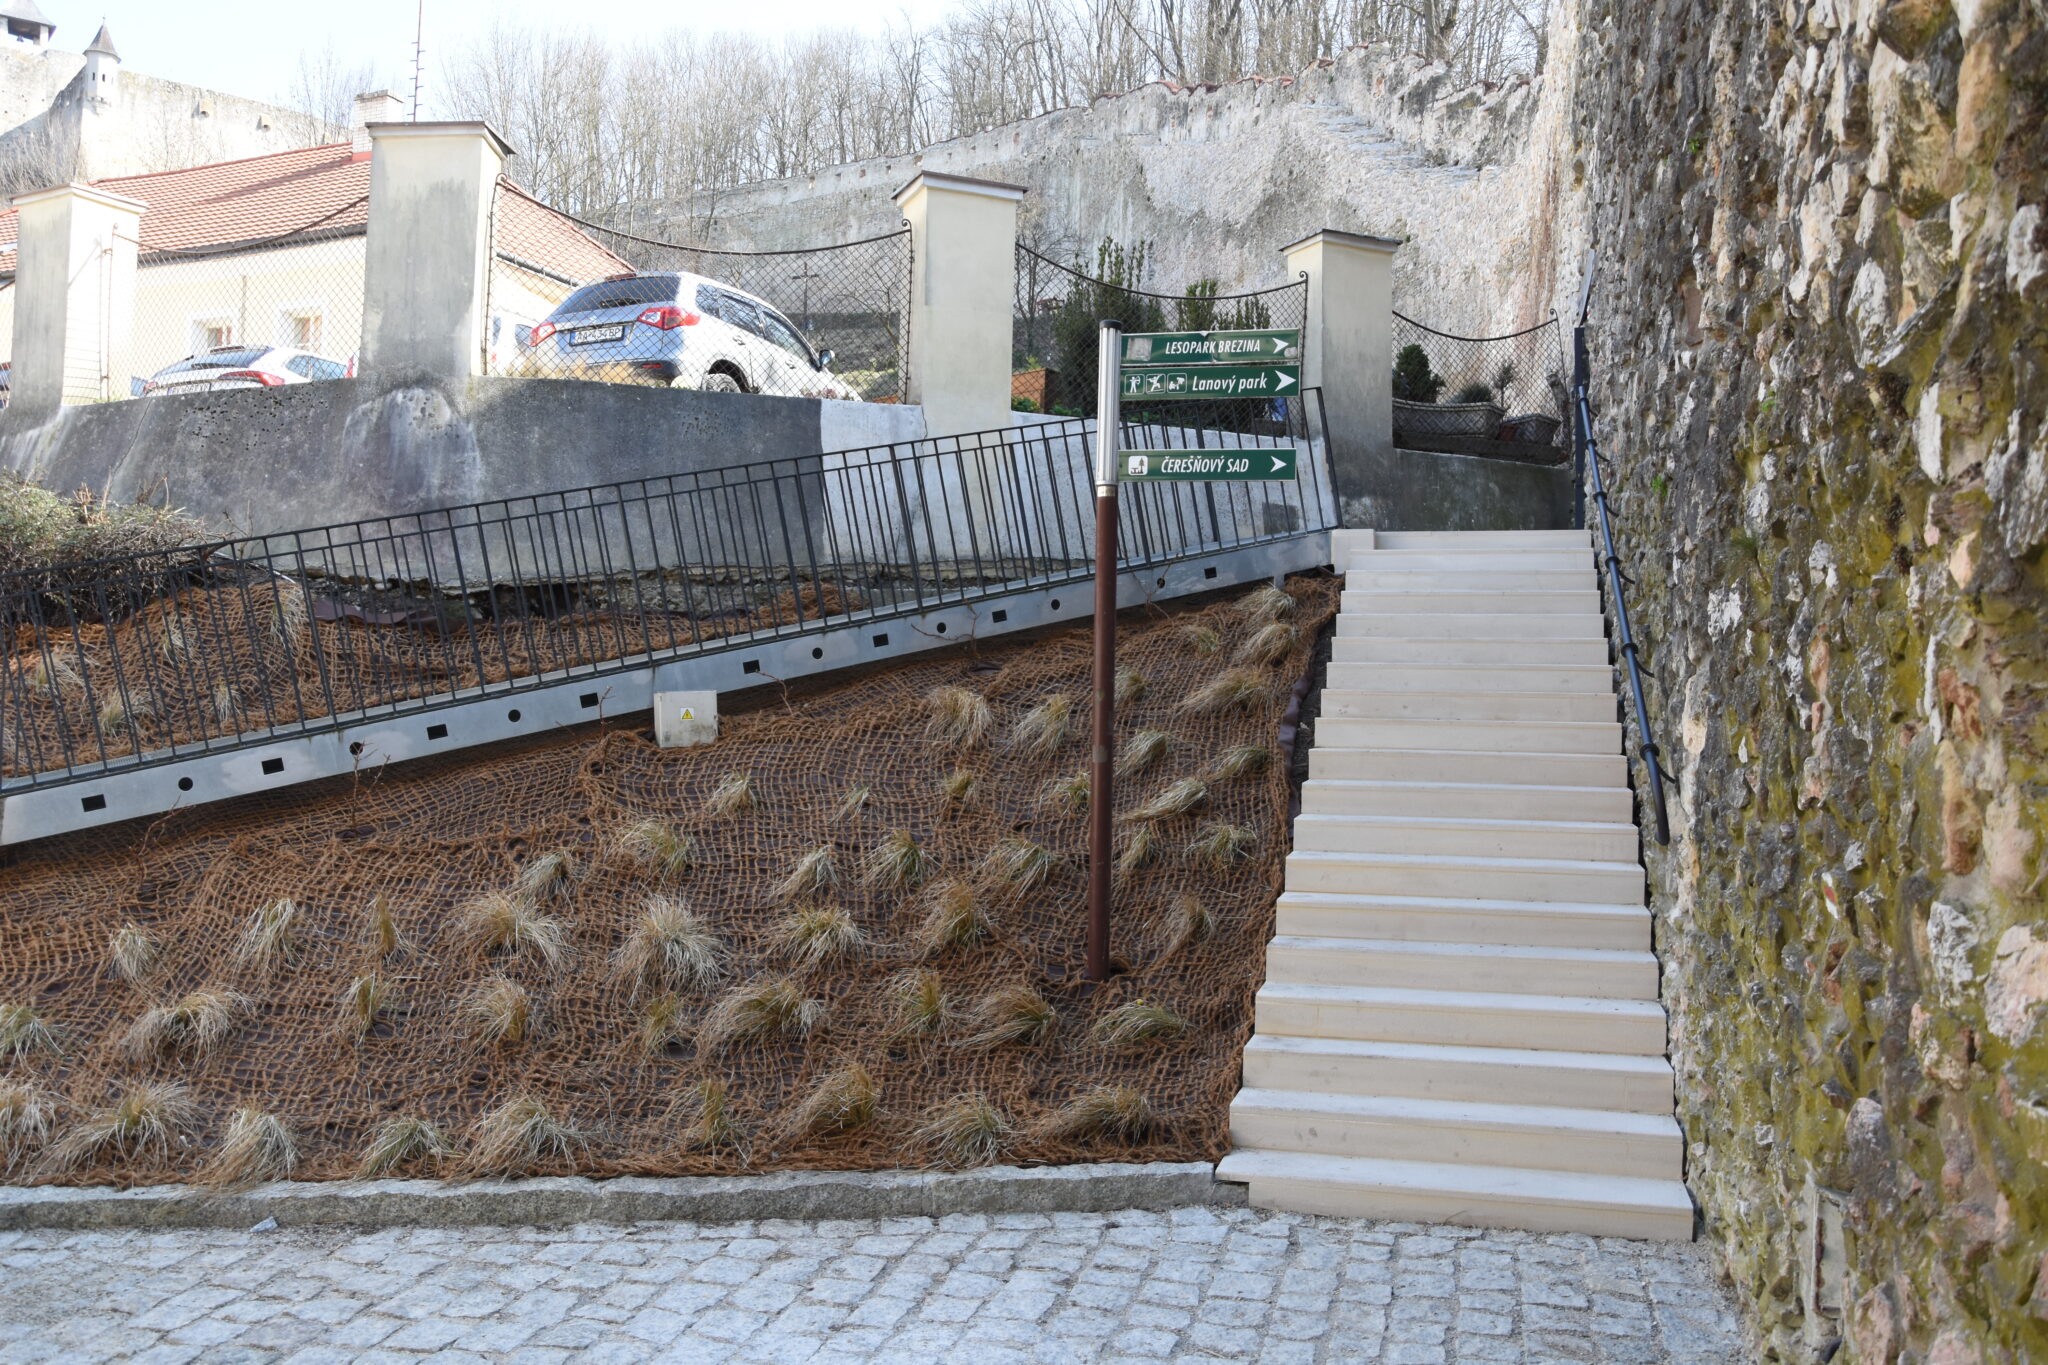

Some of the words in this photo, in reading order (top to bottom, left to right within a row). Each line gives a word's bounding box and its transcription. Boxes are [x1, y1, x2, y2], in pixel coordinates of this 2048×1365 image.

[1165, 340, 1216, 354] LESOPARK
[1218, 339, 1261, 353] BREZINA
[1192, 375, 1236, 393] Lanový
[1238, 372, 1267, 393] park
[1161, 455, 1224, 473] ČEREŠŇOVÝ
[1226, 458, 1249, 473] SAD
